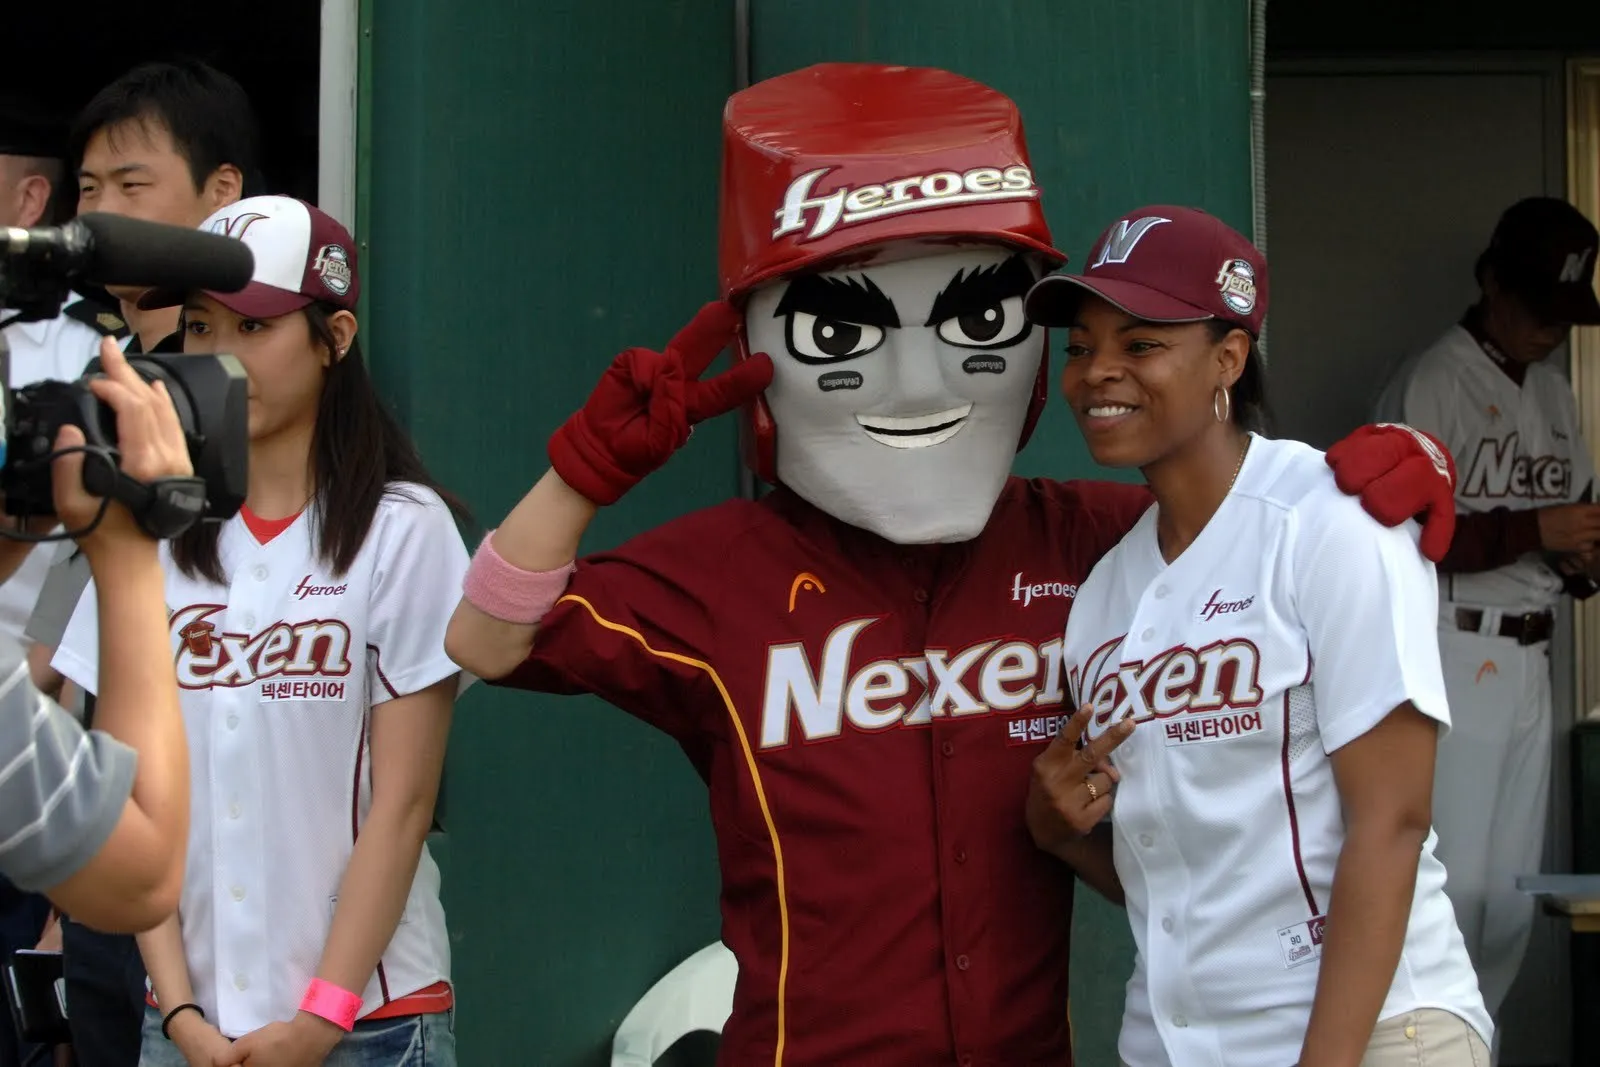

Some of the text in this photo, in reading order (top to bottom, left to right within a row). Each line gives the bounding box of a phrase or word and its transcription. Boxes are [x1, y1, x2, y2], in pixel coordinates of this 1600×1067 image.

[1091, 216, 1173, 269] N
[261, 682, 346, 700] 넥센타이어
[1165, 712, 1263, 743] 넥센타이어
